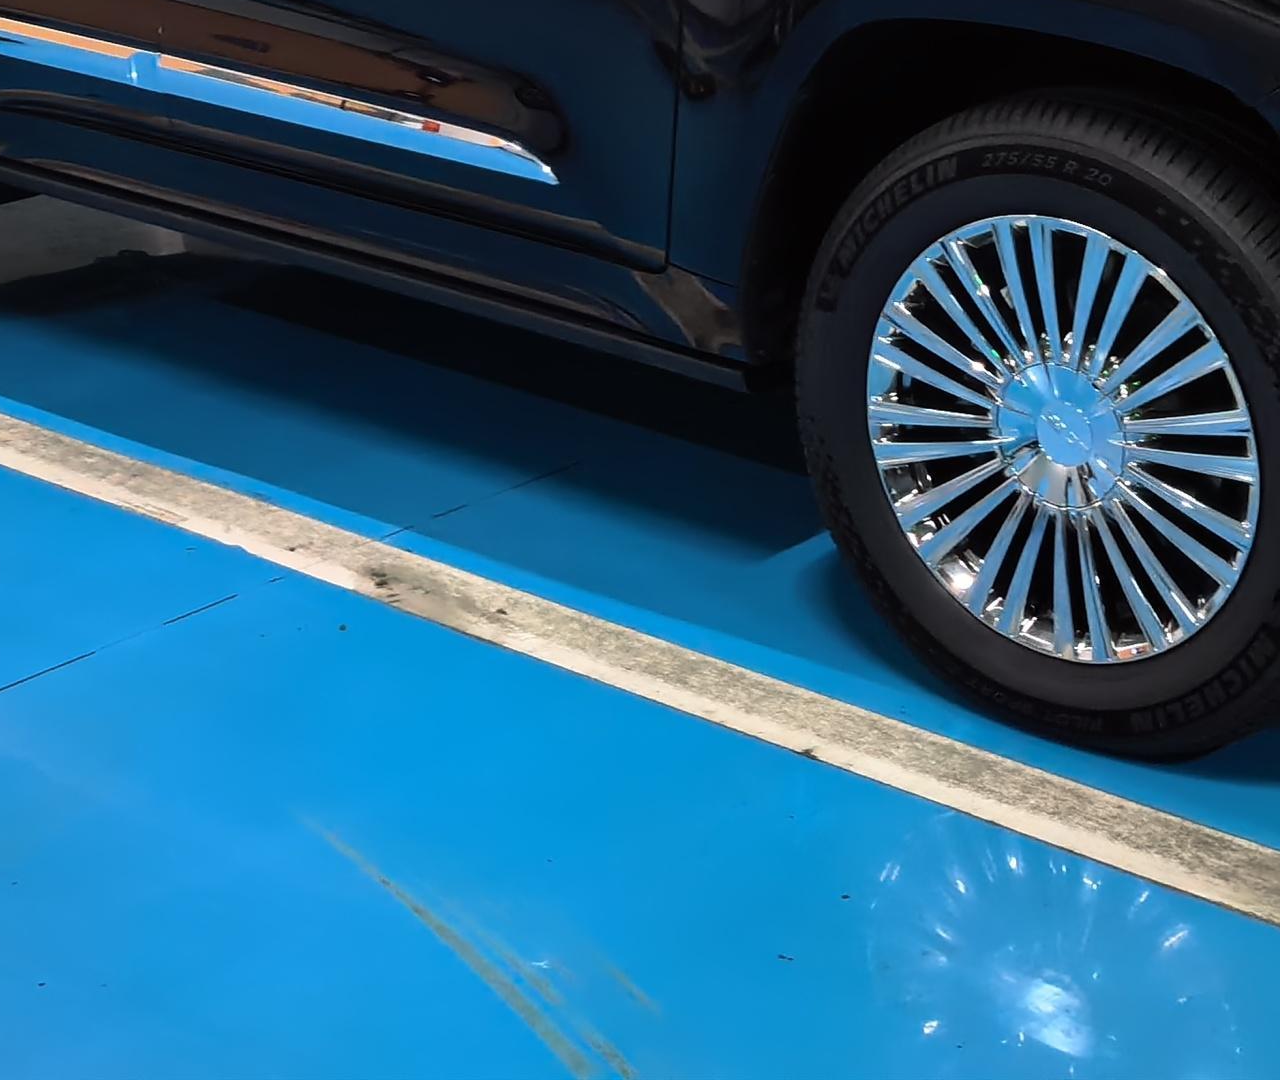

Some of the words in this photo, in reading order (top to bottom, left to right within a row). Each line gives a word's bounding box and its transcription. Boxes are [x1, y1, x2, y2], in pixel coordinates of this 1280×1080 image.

[834, 155, 960, 272] MICHELIN
[980, 151, 1058, 170] 275/55
[1062, 159, 1081, 176] R
[1086, 167, 1112, 187] 20
[1129, 631, 1280, 735] MICHELIN
